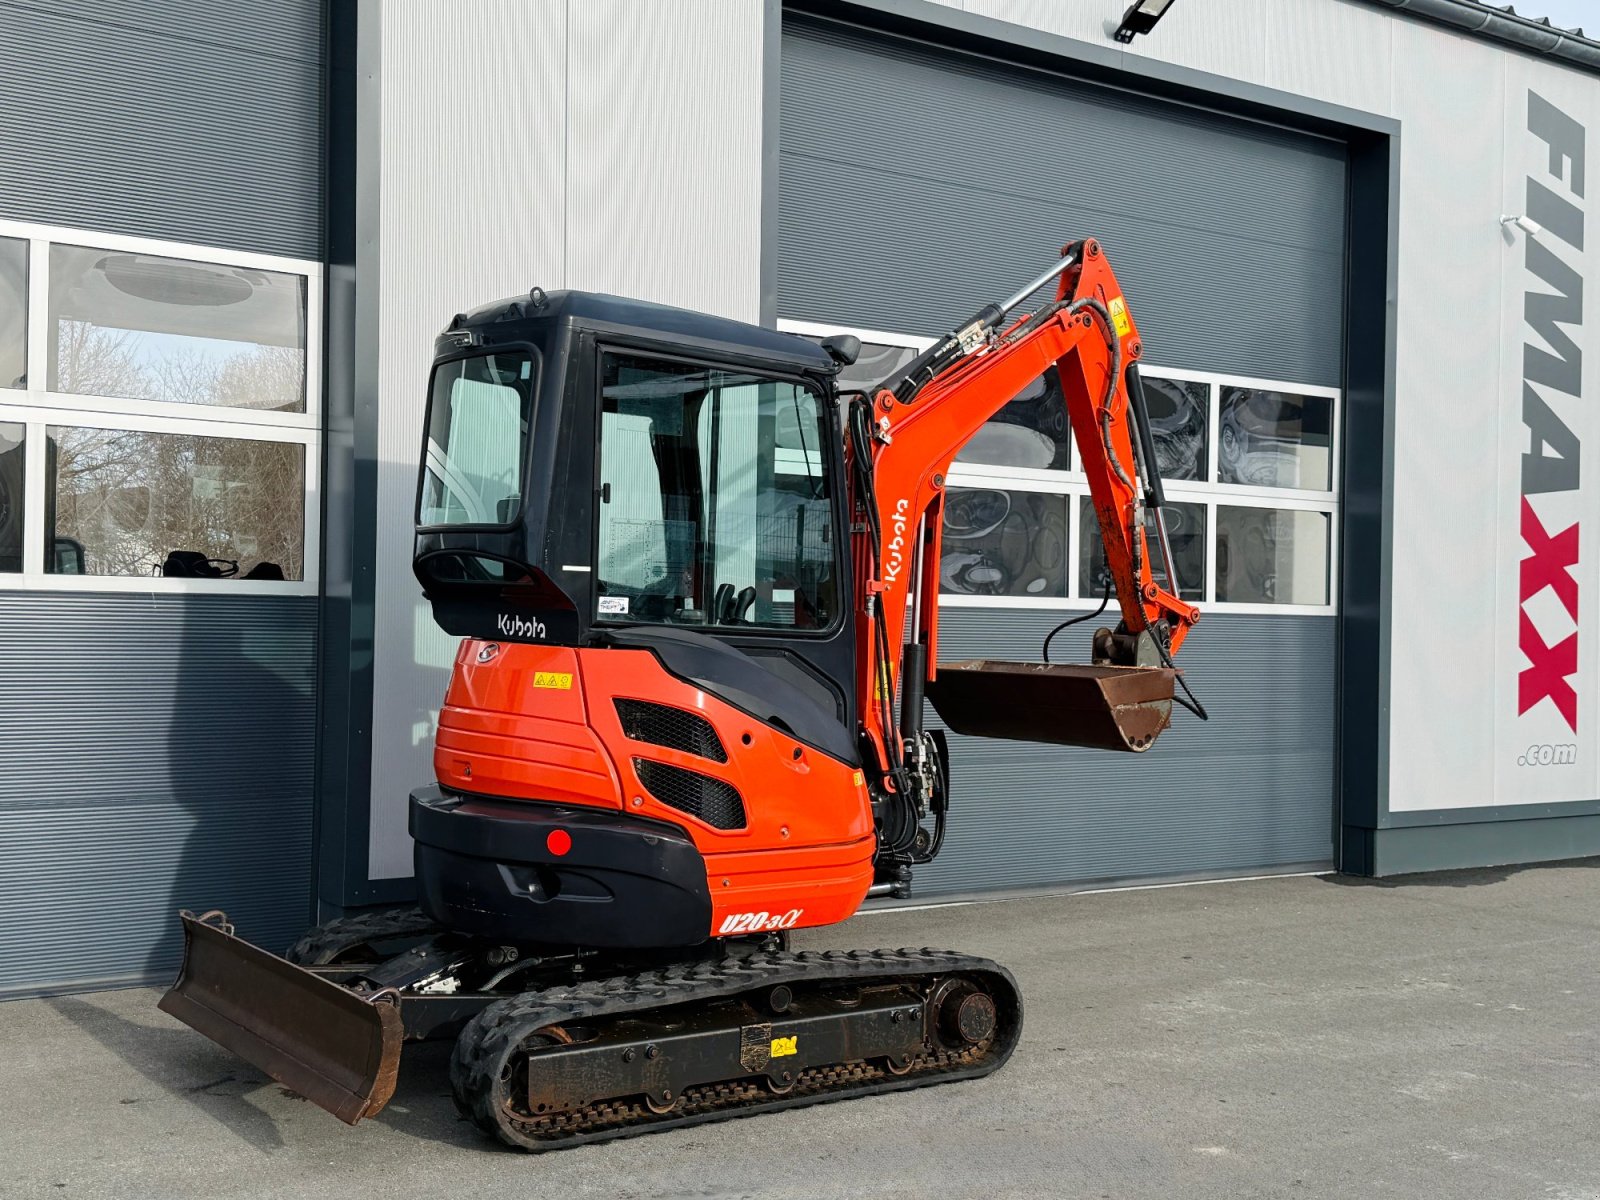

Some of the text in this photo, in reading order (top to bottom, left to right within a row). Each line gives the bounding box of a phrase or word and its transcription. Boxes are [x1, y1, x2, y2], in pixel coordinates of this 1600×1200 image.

[1518, 88, 1586, 736] FIMAXX
[884, 499, 909, 582] Kubota
[497, 613, 546, 639] Kubota
[1517, 743, 1577, 767] .com
